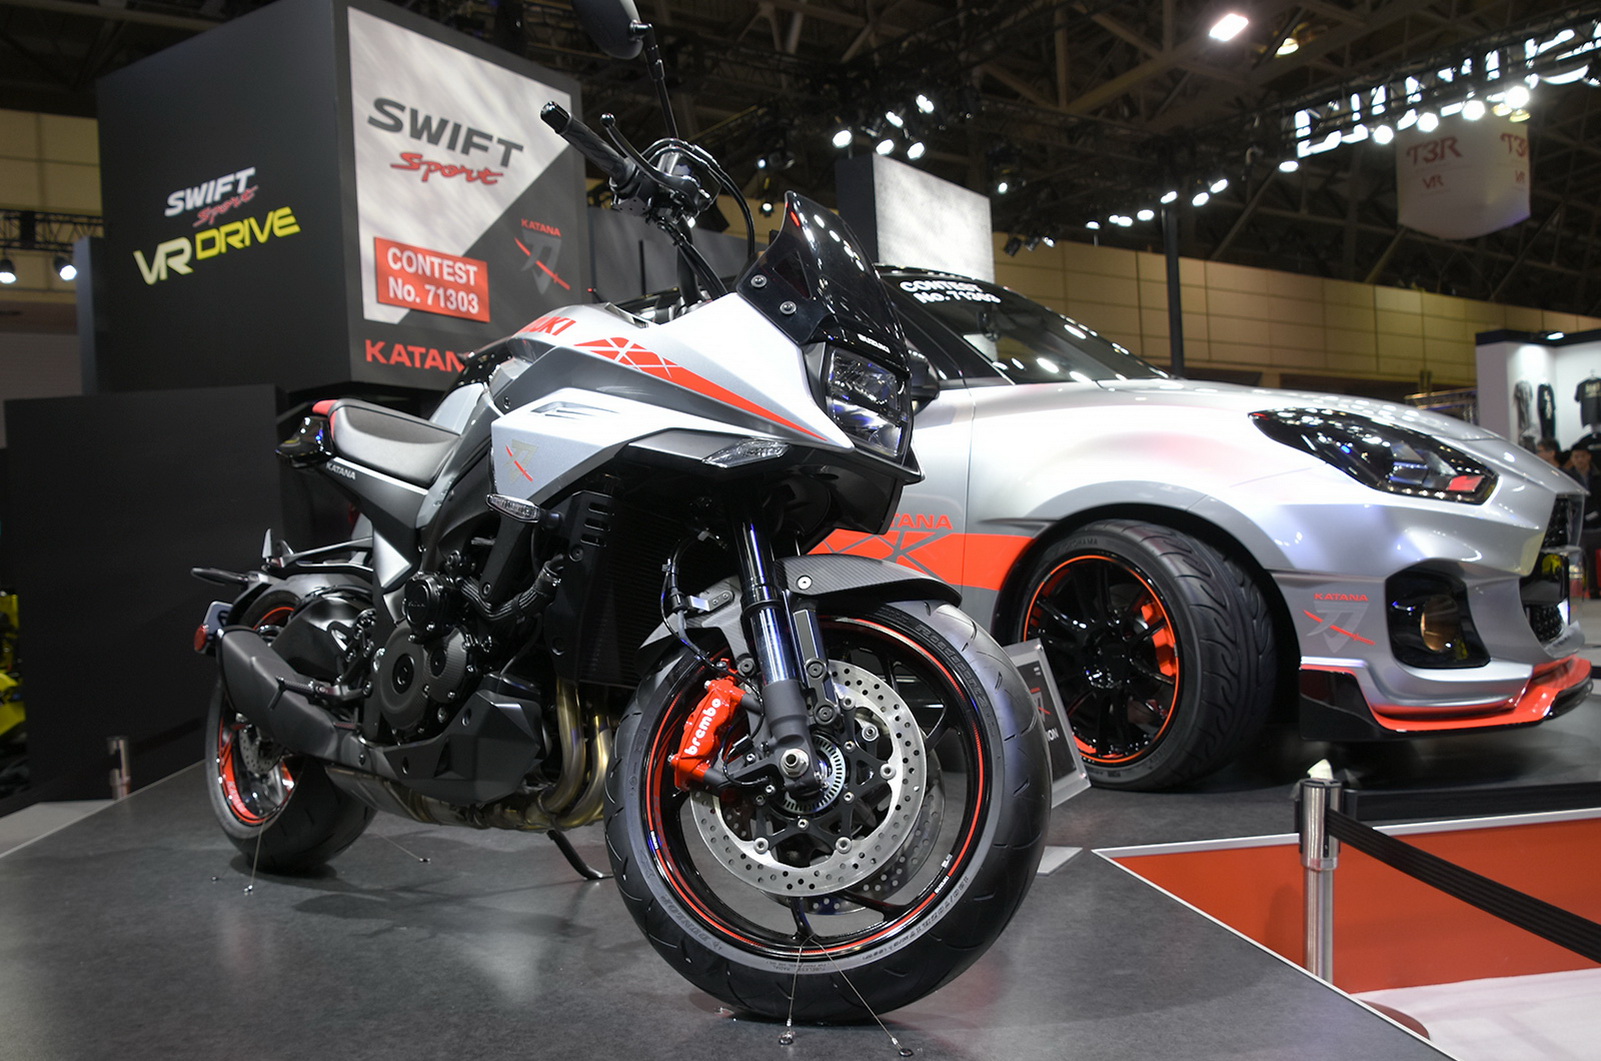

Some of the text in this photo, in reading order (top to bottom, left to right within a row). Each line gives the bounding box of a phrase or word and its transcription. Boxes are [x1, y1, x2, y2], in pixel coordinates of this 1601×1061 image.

[367, 97, 524, 168] SWIFT
[1406, 136, 1462, 164] T3R
[390, 152, 503, 186] Sport
[165, 167, 256, 217] SWIFT
[192, 185, 259, 227] Sport
[521, 218, 562, 237] KATANA
[133, 206, 301, 285] VR DRIVE
[387, 247, 478, 286] CONTEST
[388, 278, 480, 314] No. 71303
[900, 280, 983, 293] CONTEST
[365, 339, 466, 374] KATAN
[326, 462, 356, 480] KATANA
[889, 513, 953, 530] TANA
[1314, 593, 1369, 602] KATANA
[684, 698, 721, 756] brembo
